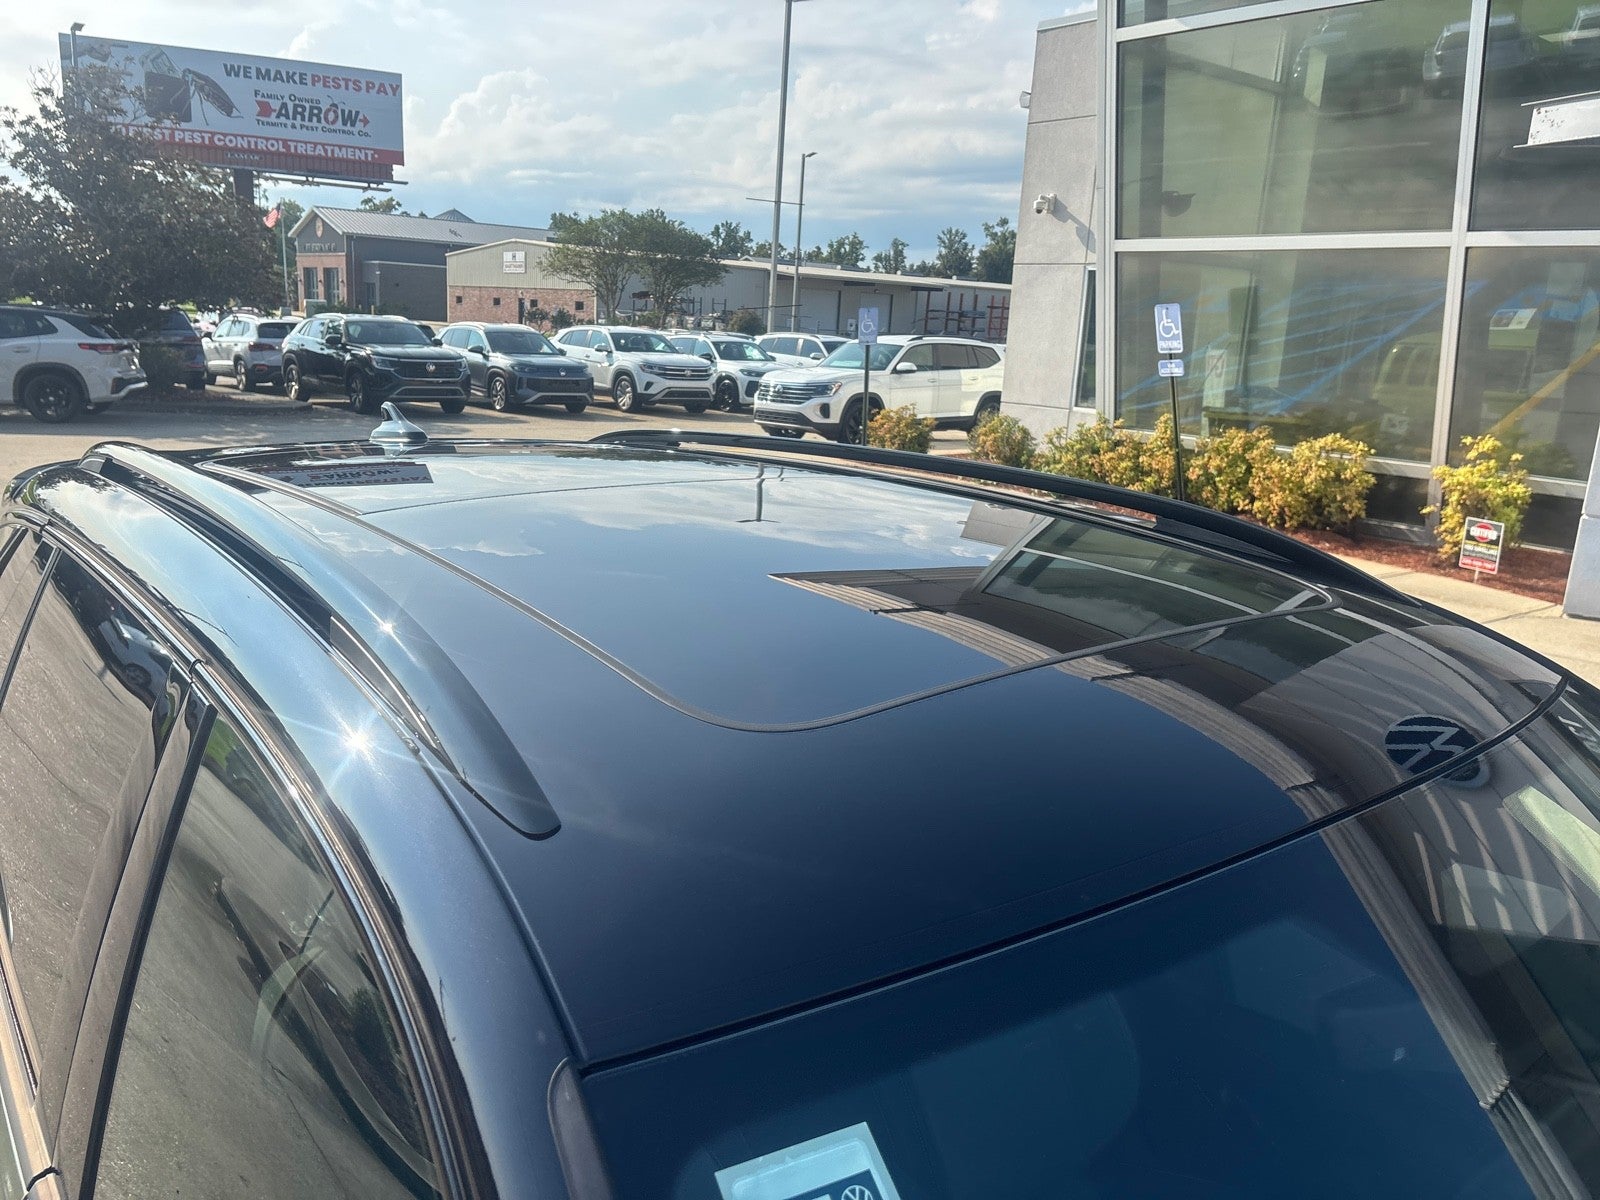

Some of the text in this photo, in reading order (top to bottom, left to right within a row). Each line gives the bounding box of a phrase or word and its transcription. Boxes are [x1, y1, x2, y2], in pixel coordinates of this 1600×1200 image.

[222, 63, 400, 96] WE MAKE PESTS PAY
[254, 89, 321, 105] FAMILY OWNED
[255, 118, 288, 129] TERMITE
[290, 122, 297, 130] &
[300, 123, 319, 132] PEST
[321, 125, 355, 136] CONTROL
[275, 102, 360, 127] ARROW
[174, 130, 211, 145] PEST
[213, 134, 286, 152] CONTROL
[287, 141, 374, 161] TREATMENT
